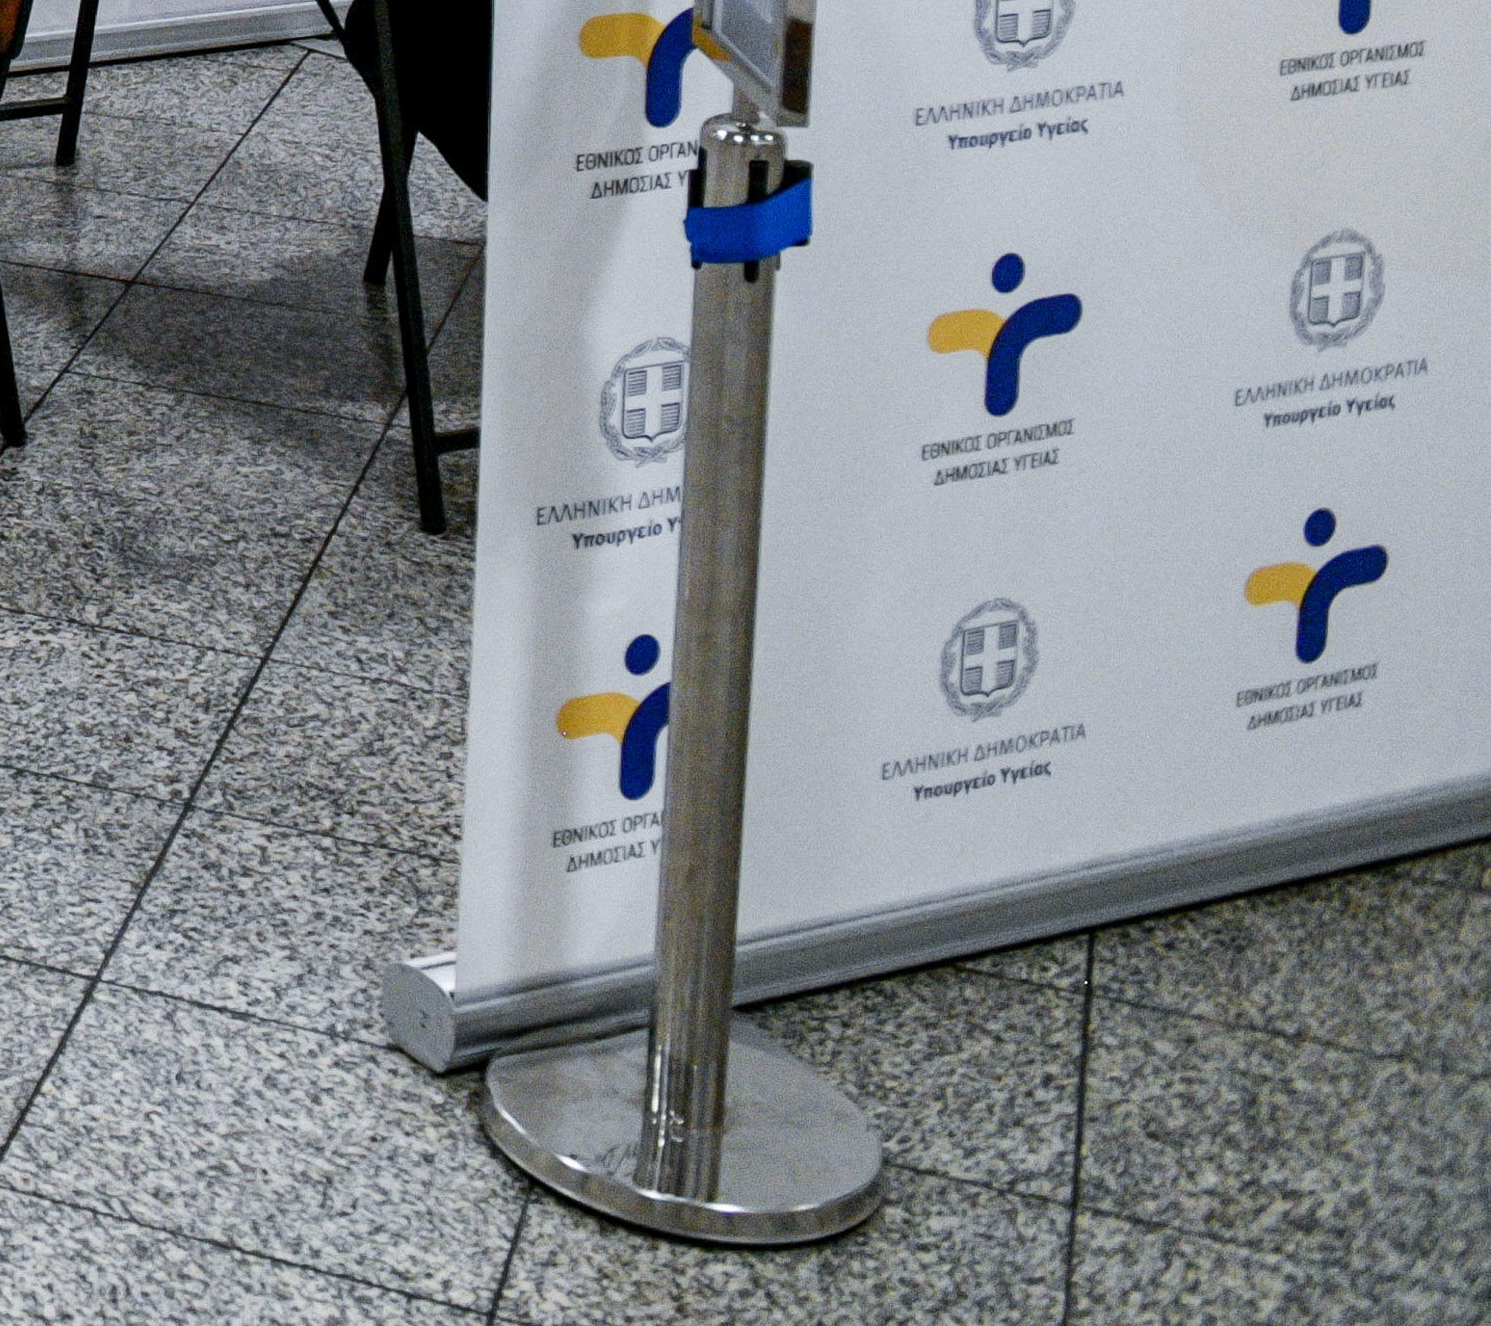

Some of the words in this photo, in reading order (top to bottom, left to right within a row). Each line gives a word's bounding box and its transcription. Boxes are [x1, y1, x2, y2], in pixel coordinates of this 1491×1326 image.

[1279, 52, 1335, 77] ΕΘΝΙΚΟΣ
[1340, 40, 1425, 67] ΟΡΓΑΝΙΣΜΟΣ
[914, 98, 1005, 127] ΕΛΛΗΝΙΚΗ
[1009, 80, 1124, 114] ΔΗΜΟΚΡΑΤΙΑ
[1290, 75, 1360, 102] ΔΗΜΟΣΙΑΣ
[1365, 69, 1410, 89] ΥΓΕΙΑΣ
[947, 125, 1033, 150] Υπουργείο
[1036, 117, 1089, 140] Υγείας
[576, 147, 643, 172] ΕΘΝΙΚΟΣ
[648, 140, 698, 162] ΟΡΓΑΝ
[590, 172, 672, 199] ΔΗΜΟΣΙΑΣ
[1234, 378, 1315, 407] ΕΛΛΗΝΙΚΗ
[1318, 357, 1428, 391] ΔΗΜΟΚΡΑΤΙΑ
[1263, 399, 1342, 428] Υπουργείο
[1345, 393, 1396, 417] Υγείας
[921, 434, 982, 461] ΕΘΝΙΚΟΣ
[986, 418, 1073, 450] ΟΡΓΑΝΙΣΜΟΣ
[933, 458, 1008, 487] ΔΗΜΟΣΙΑΣ
[1013, 448, 1059, 471] ΥΓΕΙΑΣ
[536, 493, 632, 526] ΕΛΛΗΝΙΚΗ
[571, 518, 663, 550] Υπουργείο
[1236, 680, 1292, 708] ΕΘΝΙΚΟΣ
[1296, 662, 1378, 695] ΟΡΓΑΝΙΣΜΟΣ
[1246, 701, 1315, 731] ΔΗΜΟΣΙΑΣ
[1320, 691, 1363, 713] ΥΓΕΙΑΣ
[881, 748, 969, 781] ΕΛΛΗΝΙΚΗ
[973, 723, 1086, 762] ΔΗΜΟΚΡΑΤΙΑ
[913, 771, 996, 801] Υπουργείο
[1000, 759, 1052, 785] Υγείας
[552, 819, 617, 848] ΕΘΝΙΚΟΣ
[566, 840, 646, 873] ΔΗΜΟΣΙΑΣ
